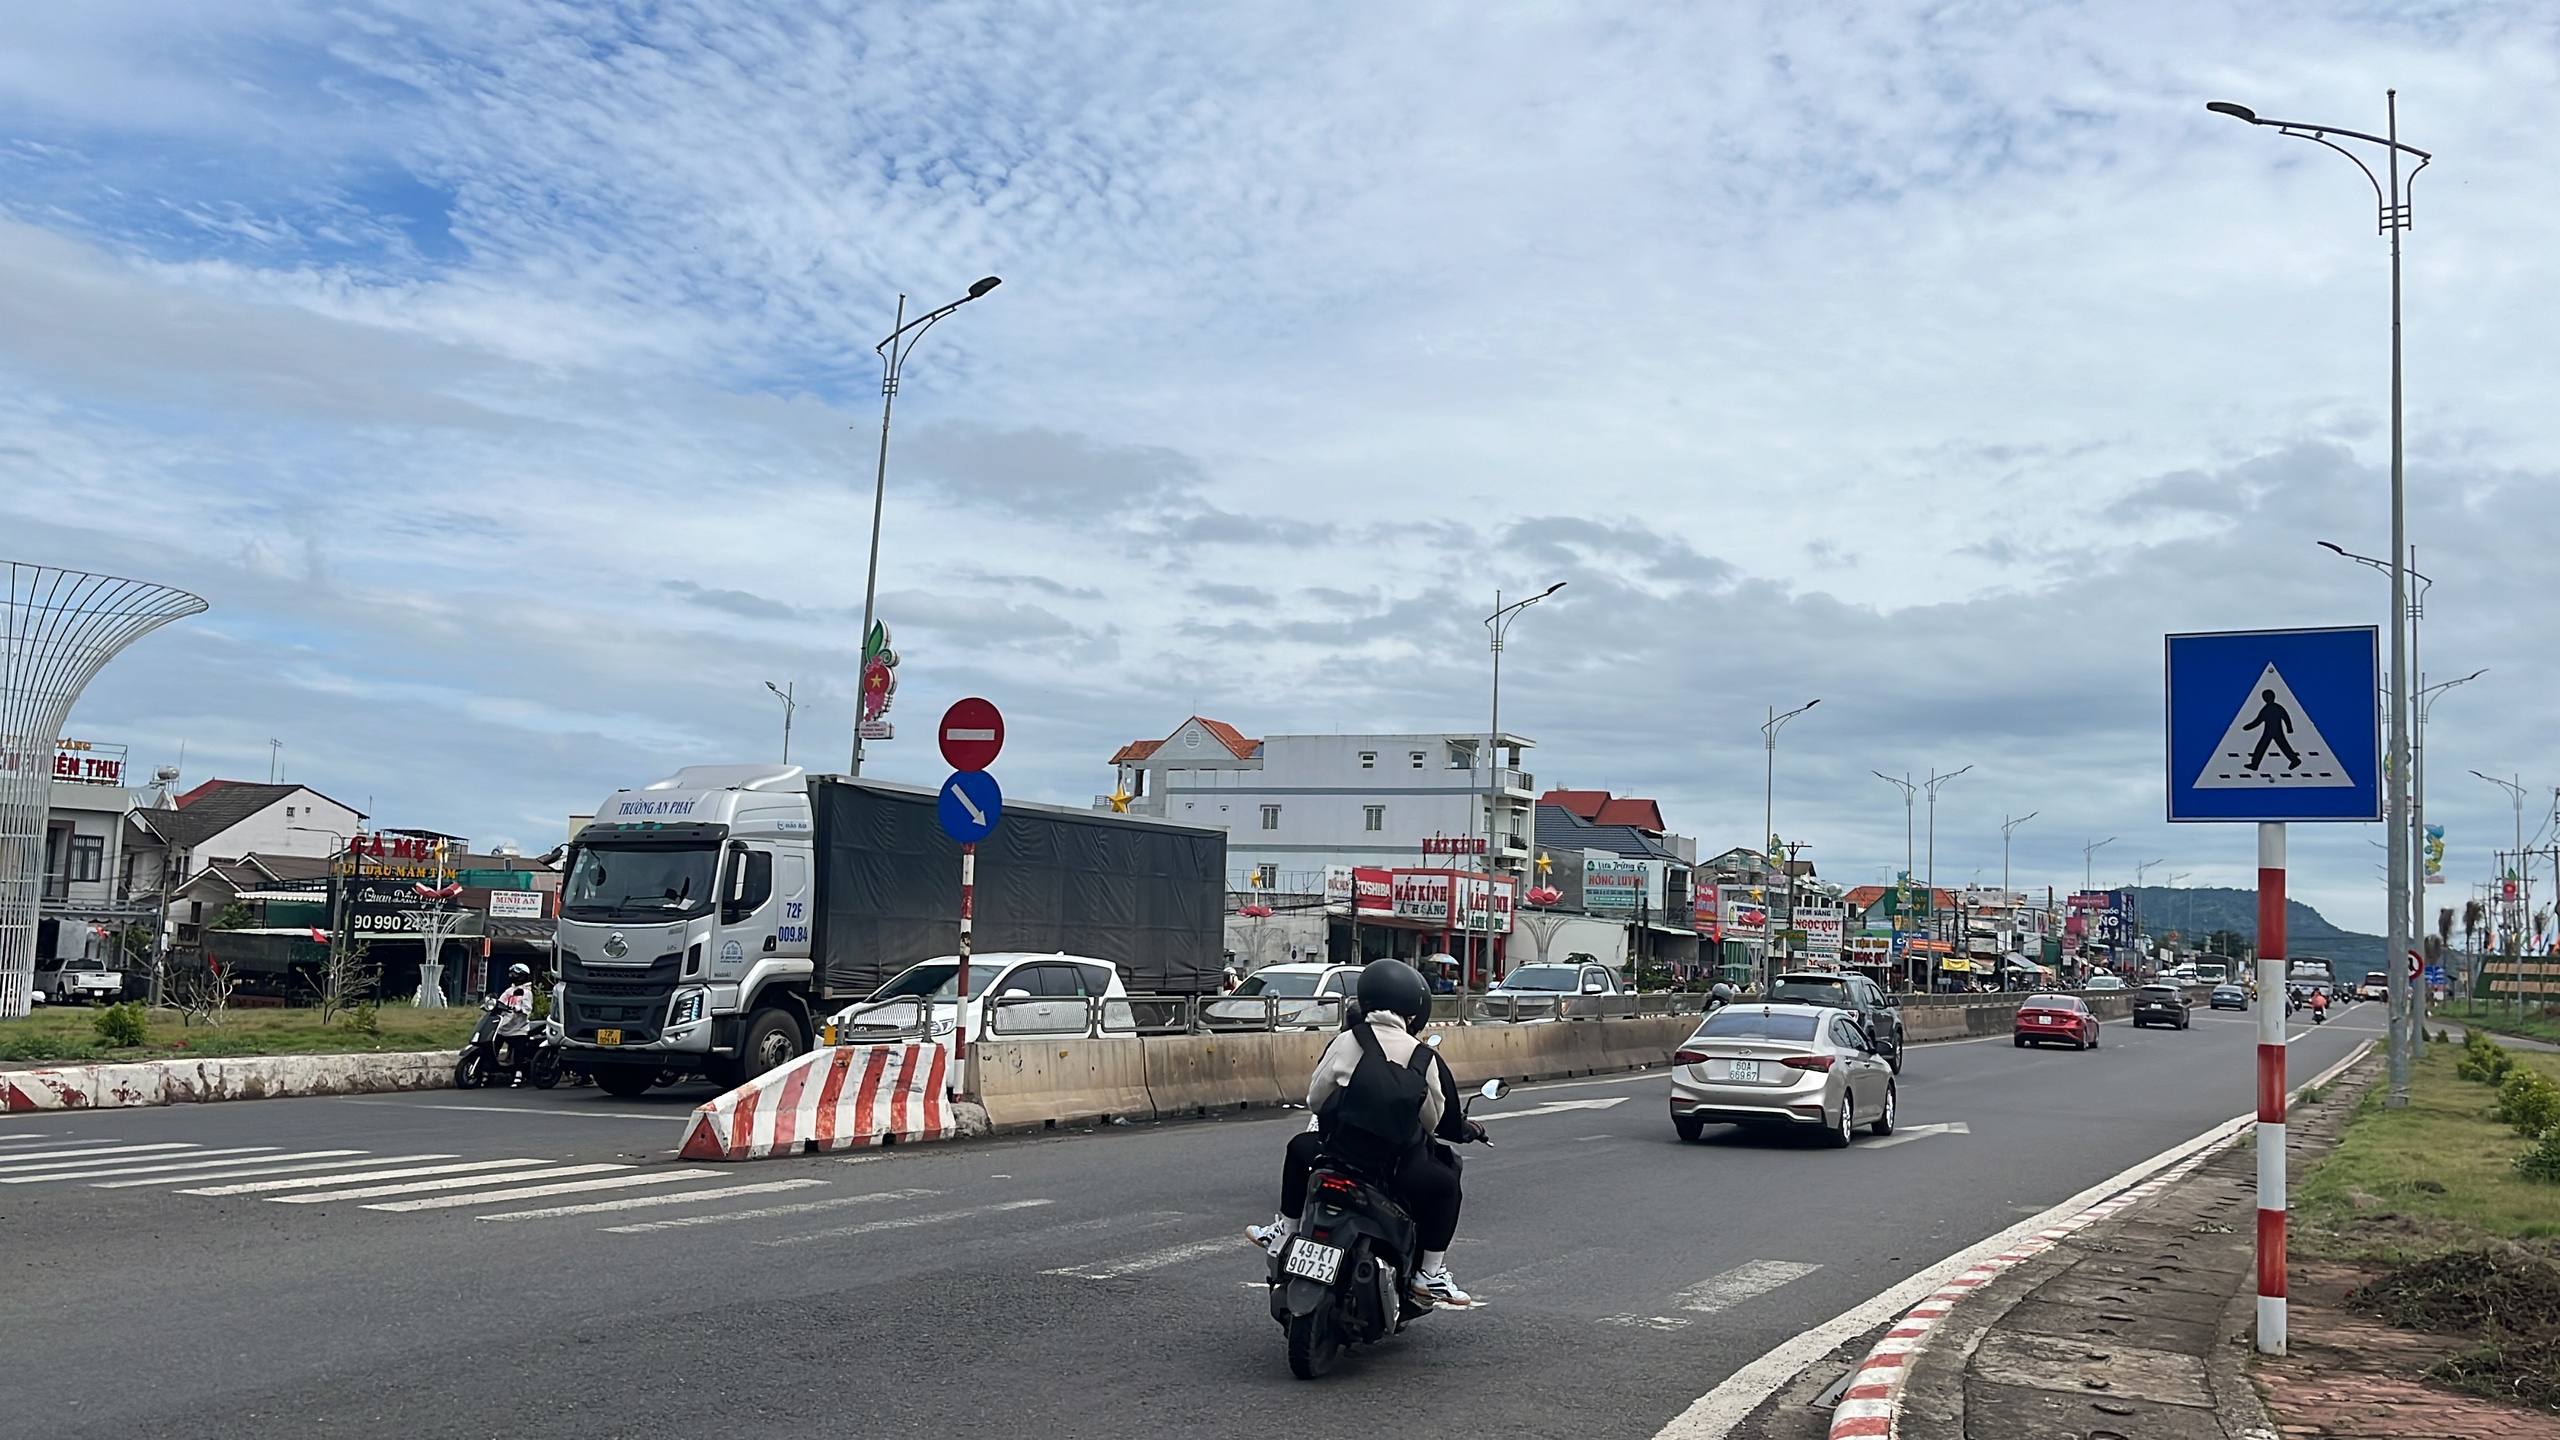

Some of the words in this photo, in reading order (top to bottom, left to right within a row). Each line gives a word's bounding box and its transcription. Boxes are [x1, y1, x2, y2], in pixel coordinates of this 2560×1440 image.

[86, 759, 120, 779] THU
[654, 802, 670, 814] AN
[669, 797, 696, 814] PHÁT
[1356, 881, 1392, 898] TOSHIBA
[1395, 876, 1416, 902] MẮT
[1418, 879, 1448, 903] KÍNH
[786, 902, 802, 918] 72F
[1814, 908, 1832, 916] VÀNG
[374, 916, 401, 930] 990
[1795, 920, 1820, 931] NGỌC
[778, 926, 808, 942] 009.84
[1736, 1062, 1752, 1070] 60A
[1288, 1256, 1334, 1282] 907.52
